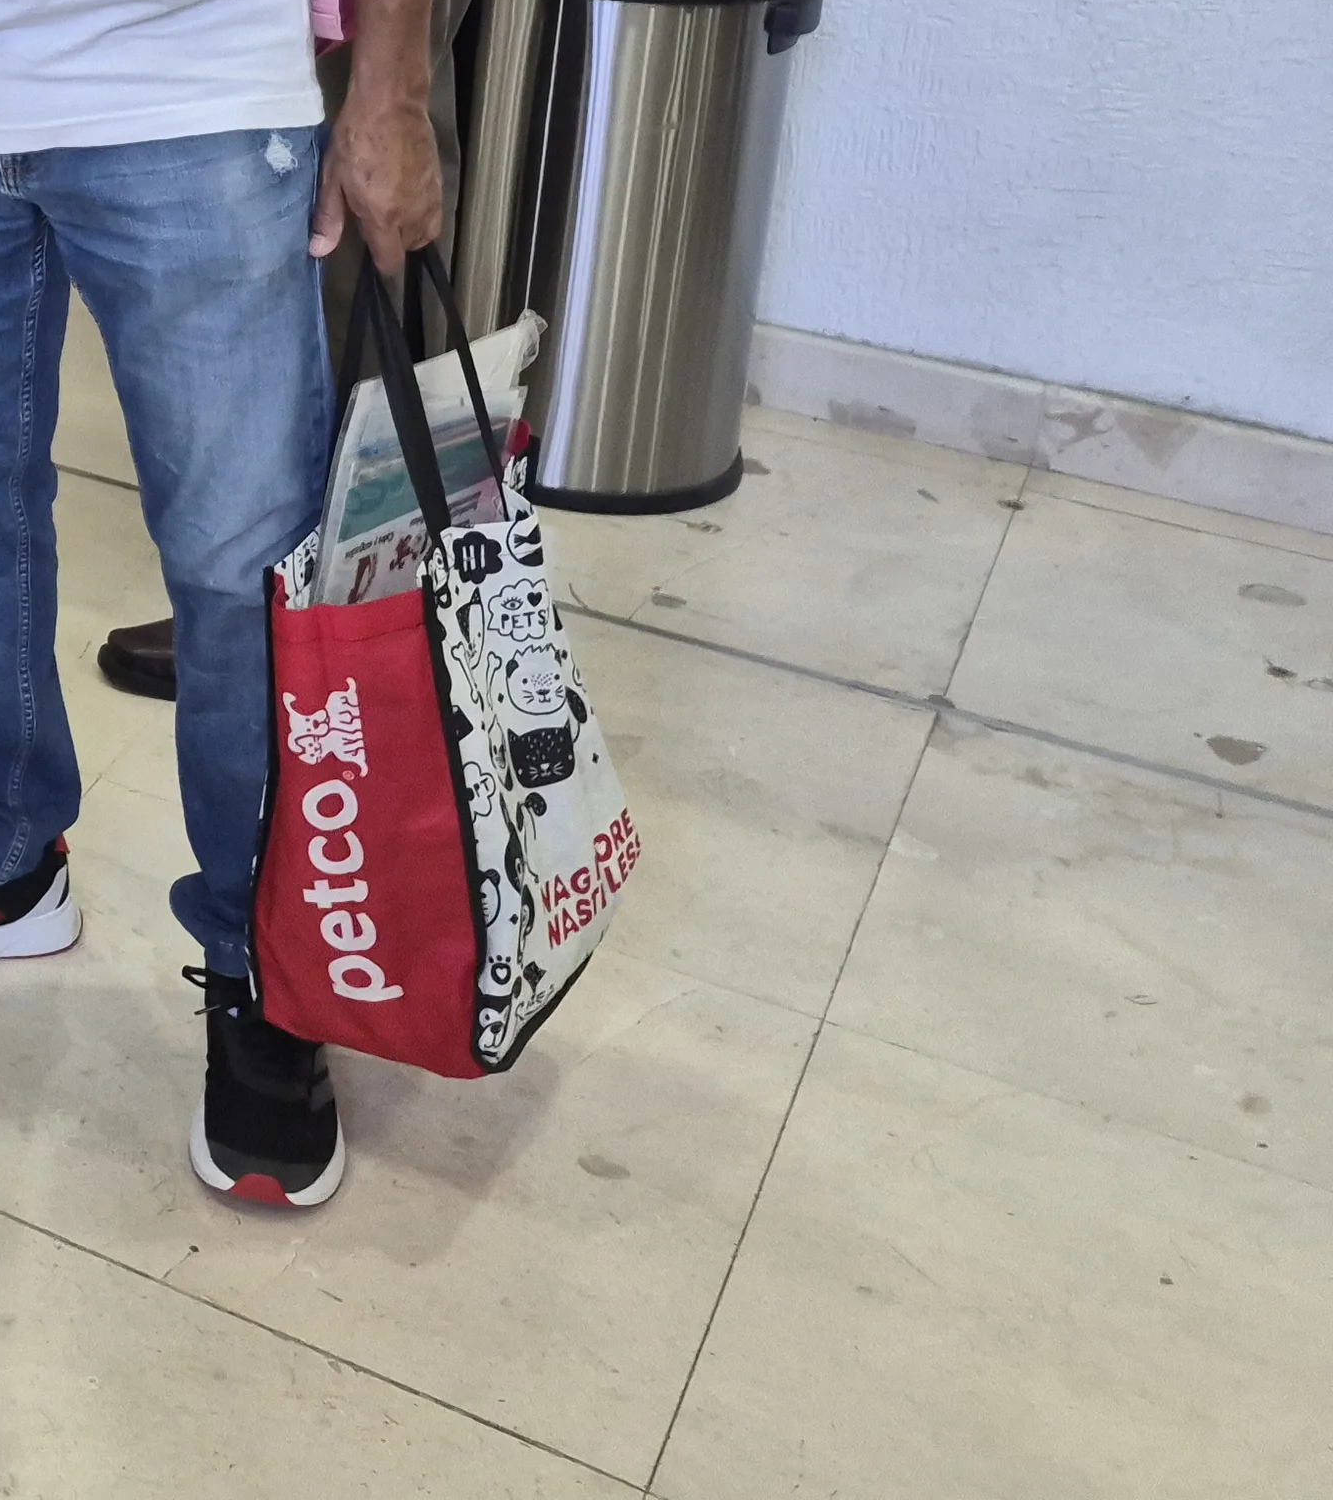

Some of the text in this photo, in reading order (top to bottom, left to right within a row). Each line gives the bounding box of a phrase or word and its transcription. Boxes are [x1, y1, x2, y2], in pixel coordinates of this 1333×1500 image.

[462, 544, 485, 572] HI
[501, 609, 548, 630] PETS
[302, 779, 404, 1003] petco
